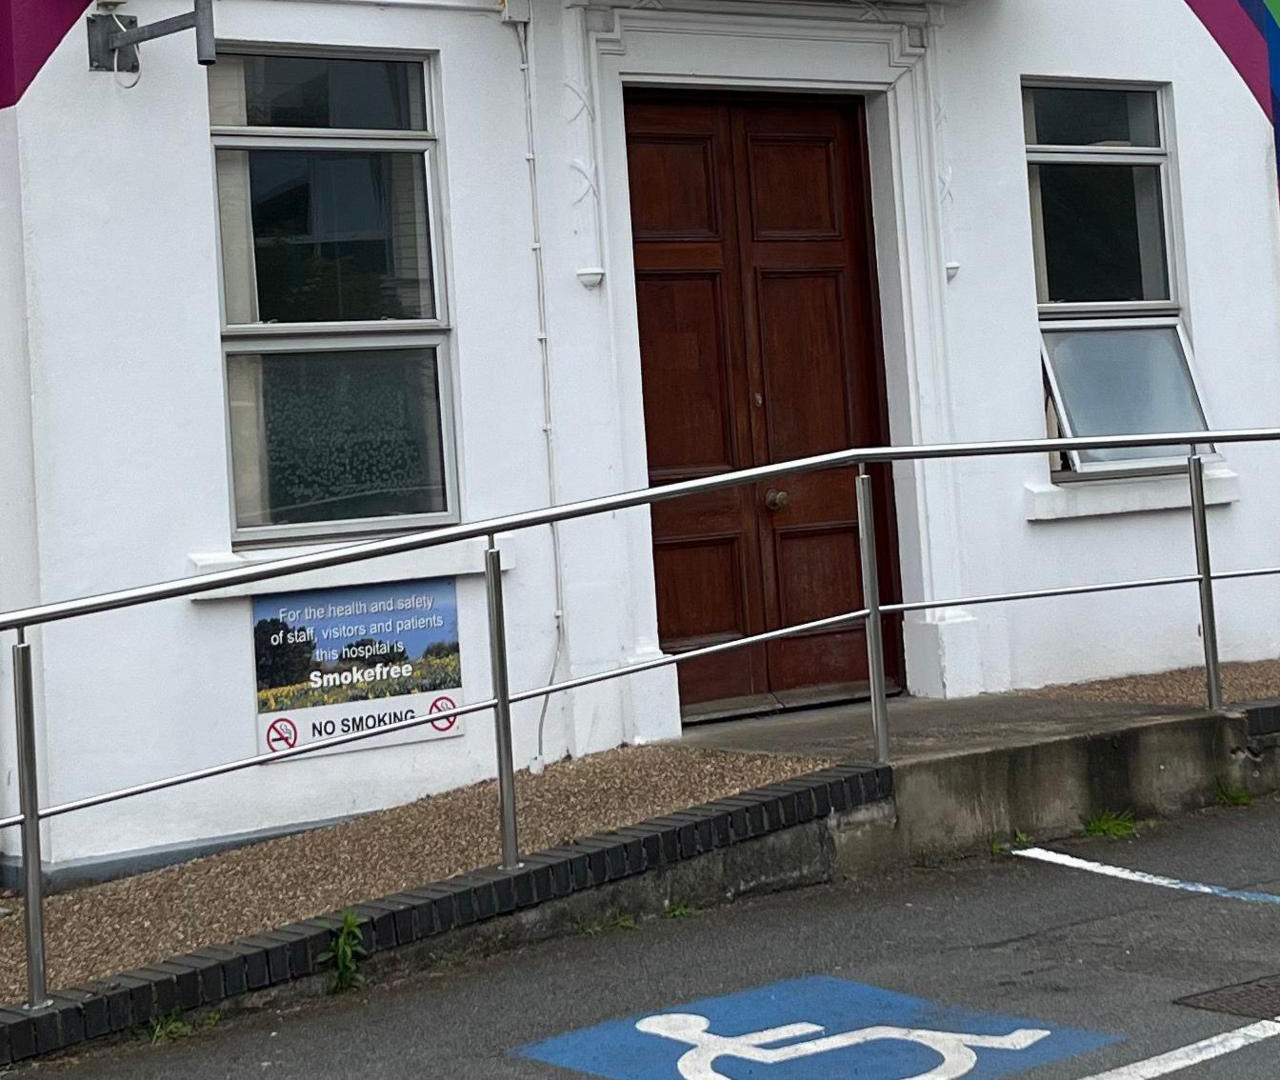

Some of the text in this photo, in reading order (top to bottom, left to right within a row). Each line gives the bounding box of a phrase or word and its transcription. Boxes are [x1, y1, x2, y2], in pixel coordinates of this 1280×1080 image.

[279, 594, 433, 623] For the health and safety
[270, 613, 444, 646] of staff, visitors and patients
[315, 639, 405, 662] this hospital is
[309, 662, 413, 689] Smokefree
[311, 708, 416, 738] NO SMOKING
